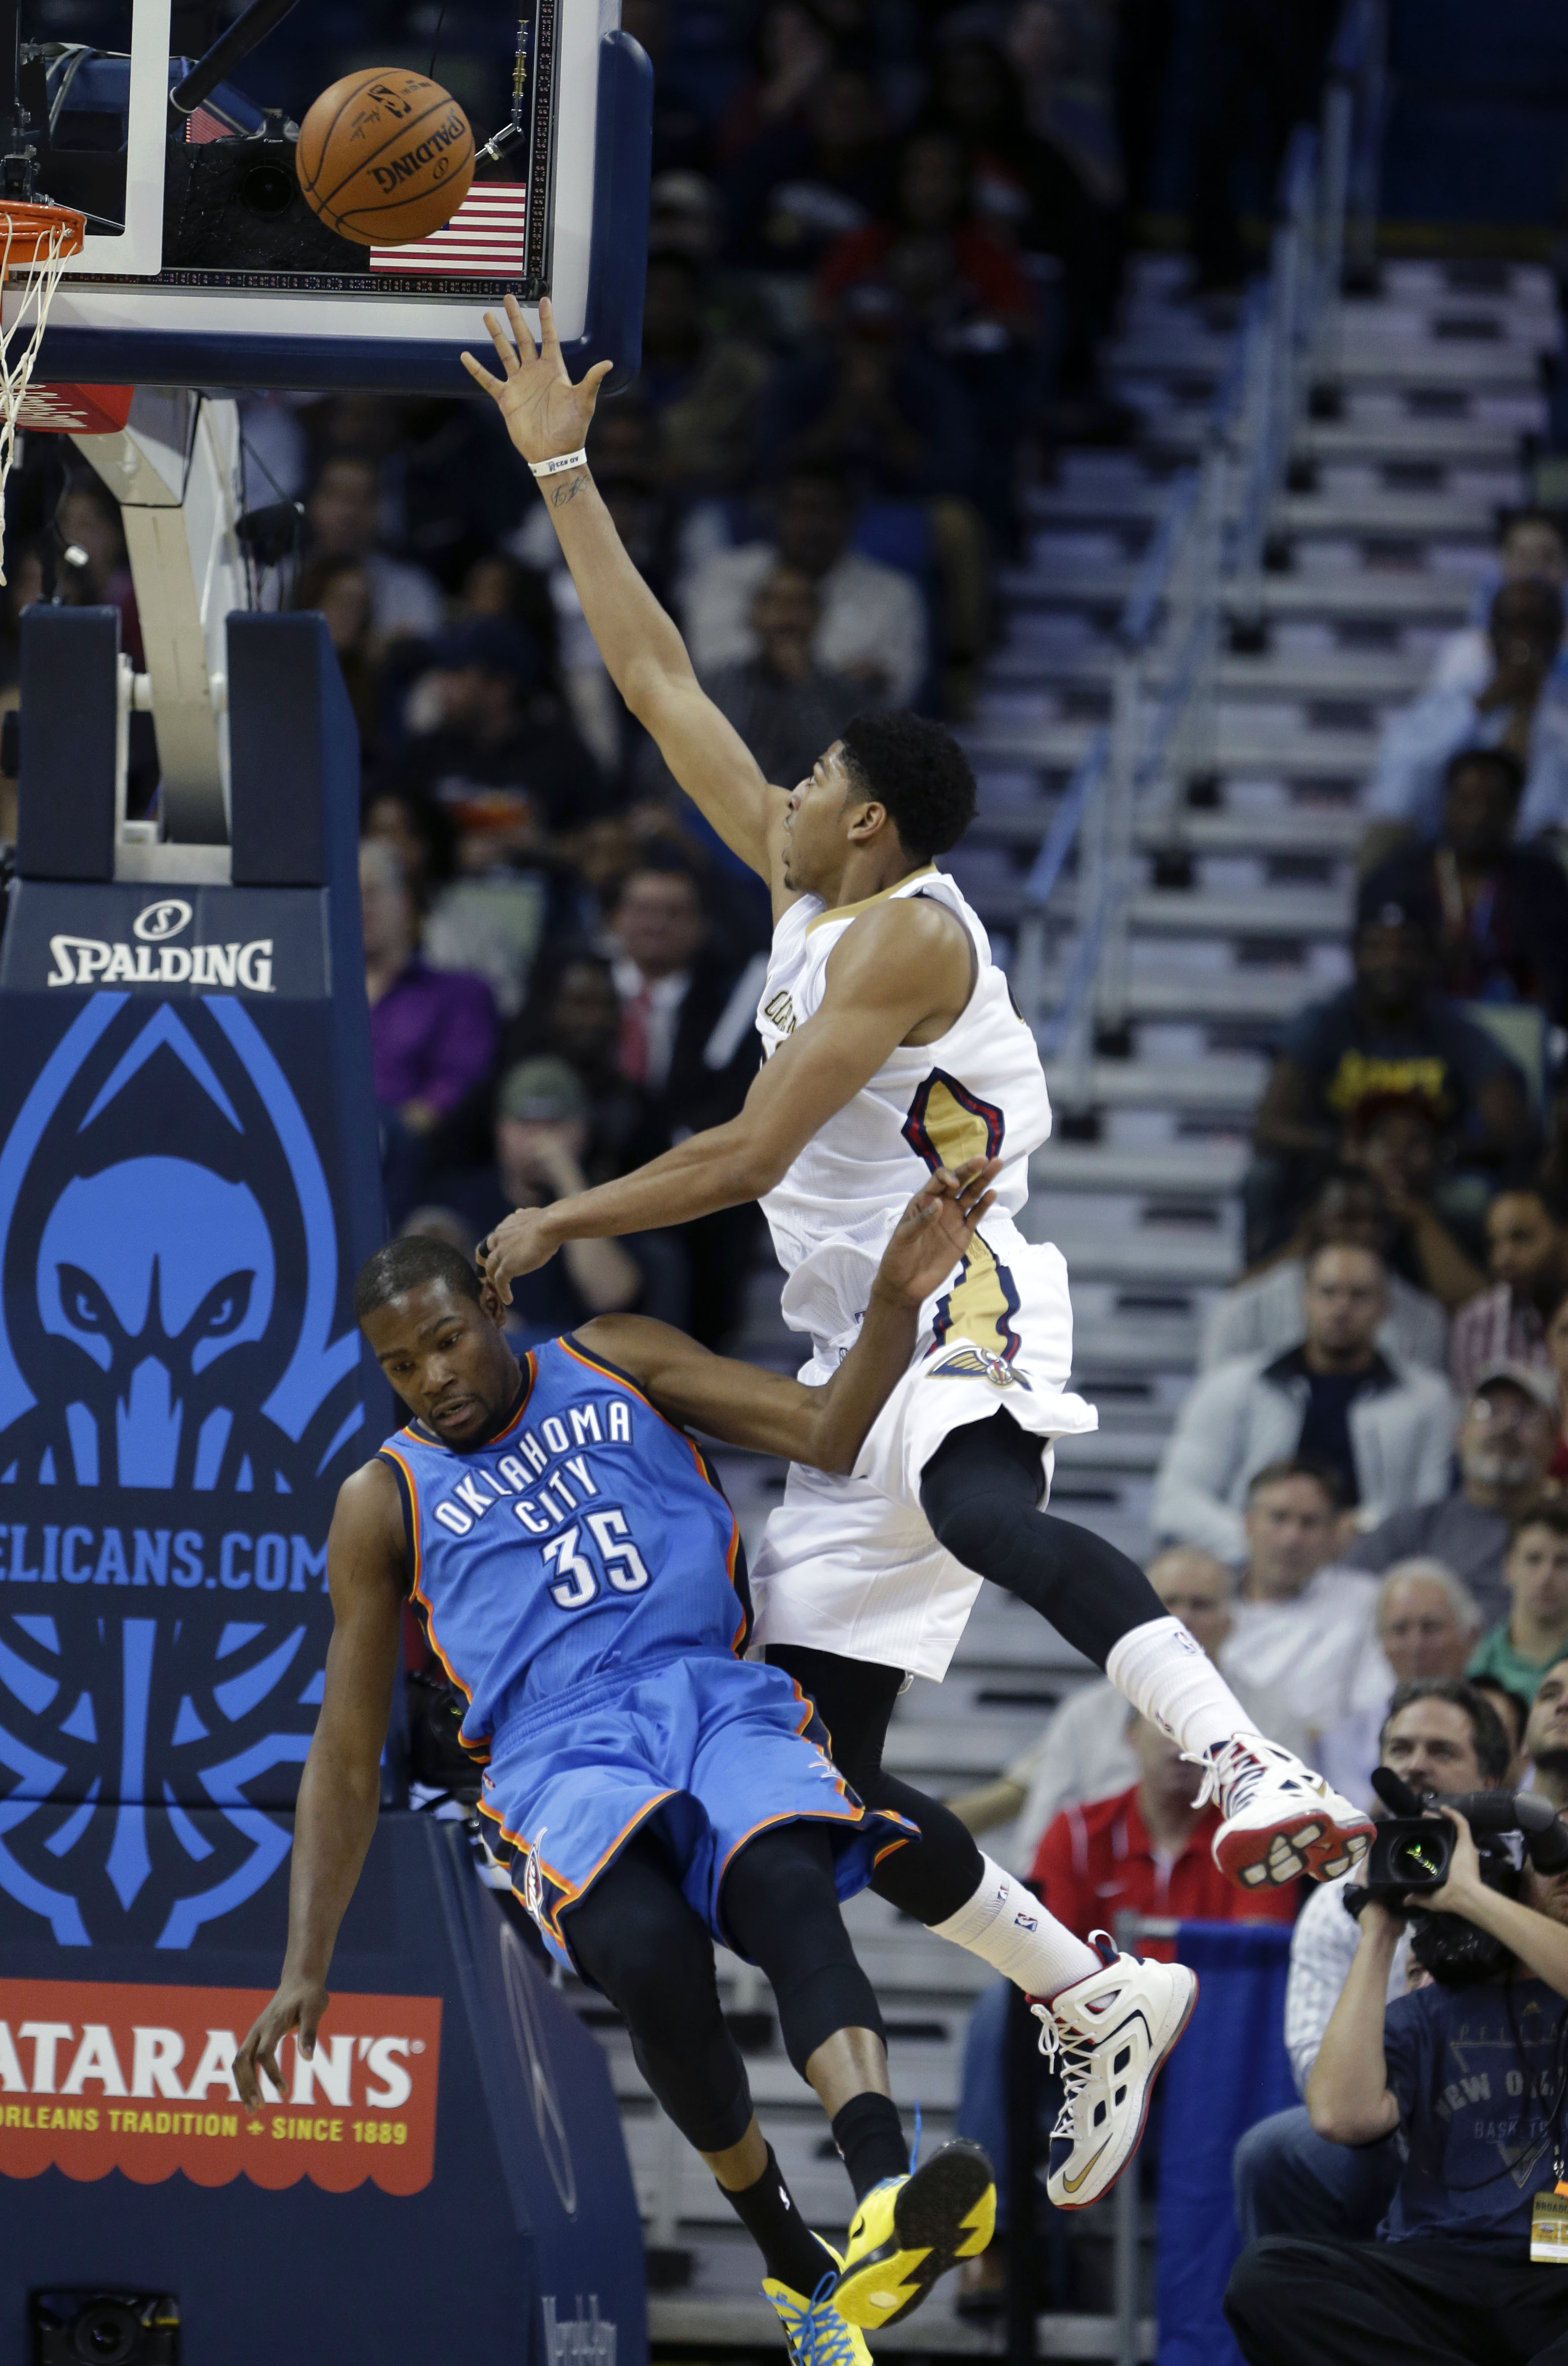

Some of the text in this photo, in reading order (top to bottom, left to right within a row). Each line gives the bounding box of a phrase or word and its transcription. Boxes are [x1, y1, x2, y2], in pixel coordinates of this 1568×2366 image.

[371, 107, 465, 194] SPALDING
[48, 934, 274, 993] SPALDING
[433, 1400, 633, 1536] OKLAHOMA
[512, 1454, 601, 1535] CITY
[0, 1524, 329, 1593] LICANS.COM
[540, 1507, 652, 1612] 35
[0, 2105, 407, 2145] RLEANS TRADITION SINCE 1889
